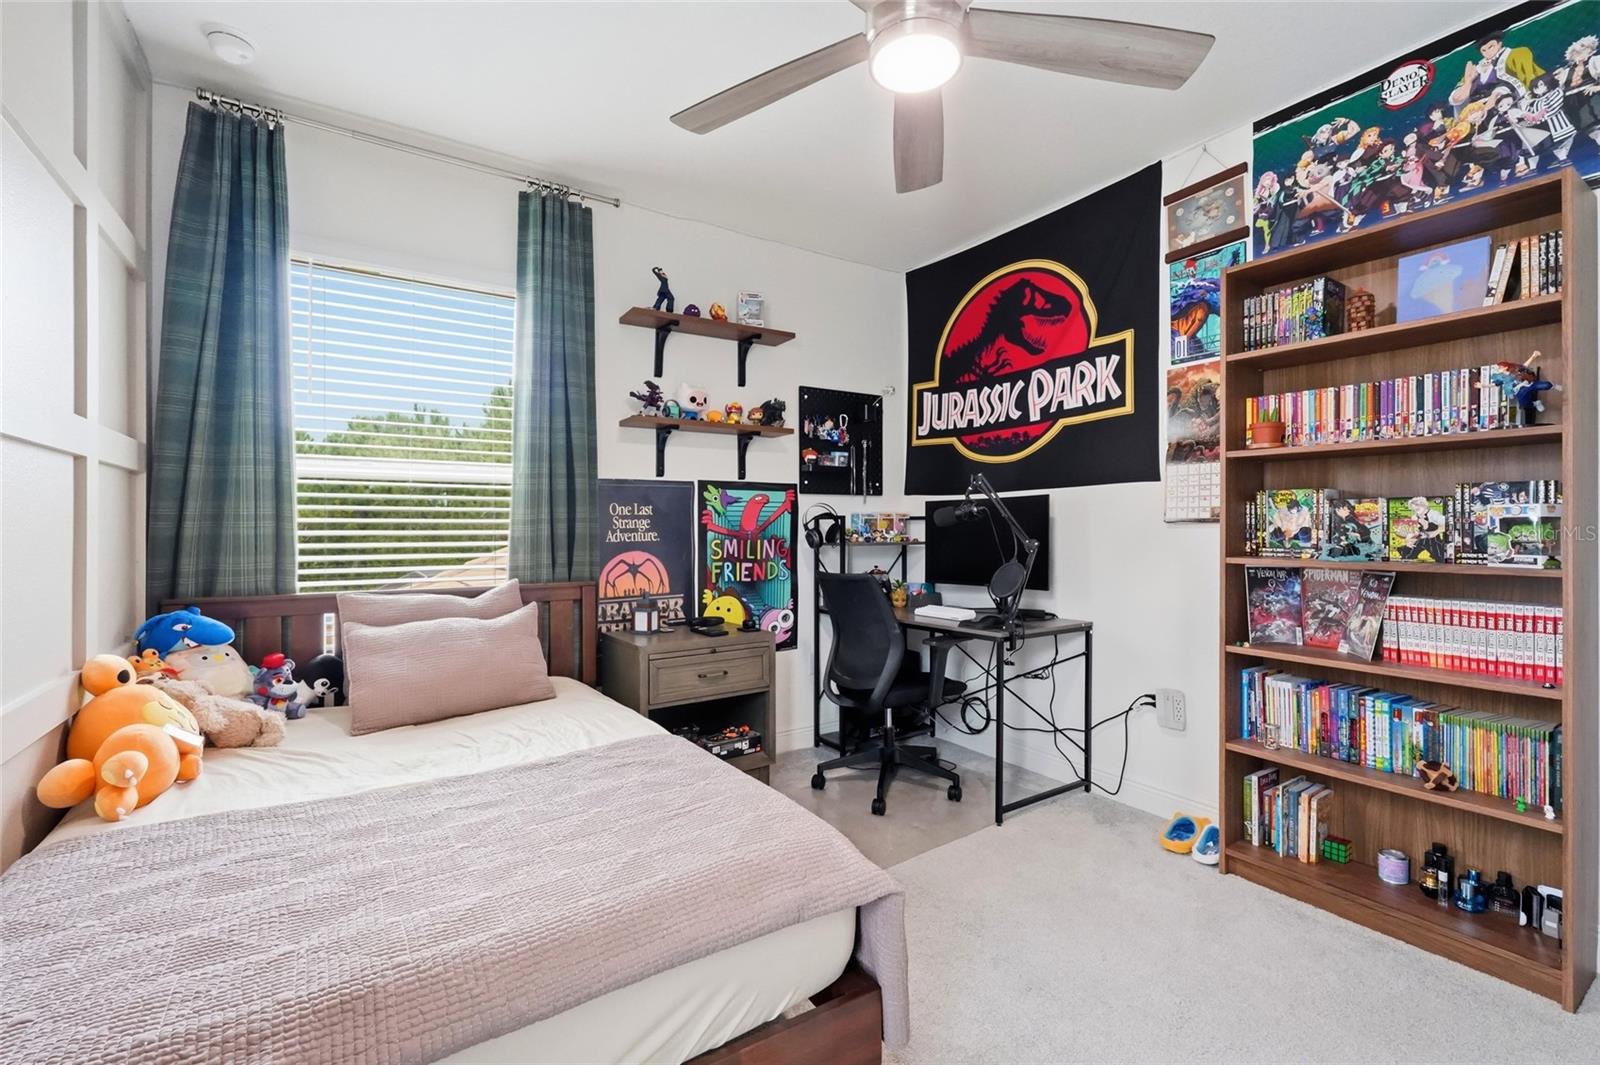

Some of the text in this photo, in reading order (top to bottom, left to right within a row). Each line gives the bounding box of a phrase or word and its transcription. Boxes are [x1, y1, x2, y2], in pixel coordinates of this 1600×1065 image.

[1379, 74, 1428, 103] SLAYER
[1380, 65, 1427, 92] DEMON
[918, 354, 1122, 436] JURASSIC PARK
[609, 502, 653, 516] One Last
[612, 516, 651, 532] Strange
[605, 530, 660, 543] Adventure.
[711, 538, 788, 560] SMILING
[711, 560, 789, 583] FRIENDS
